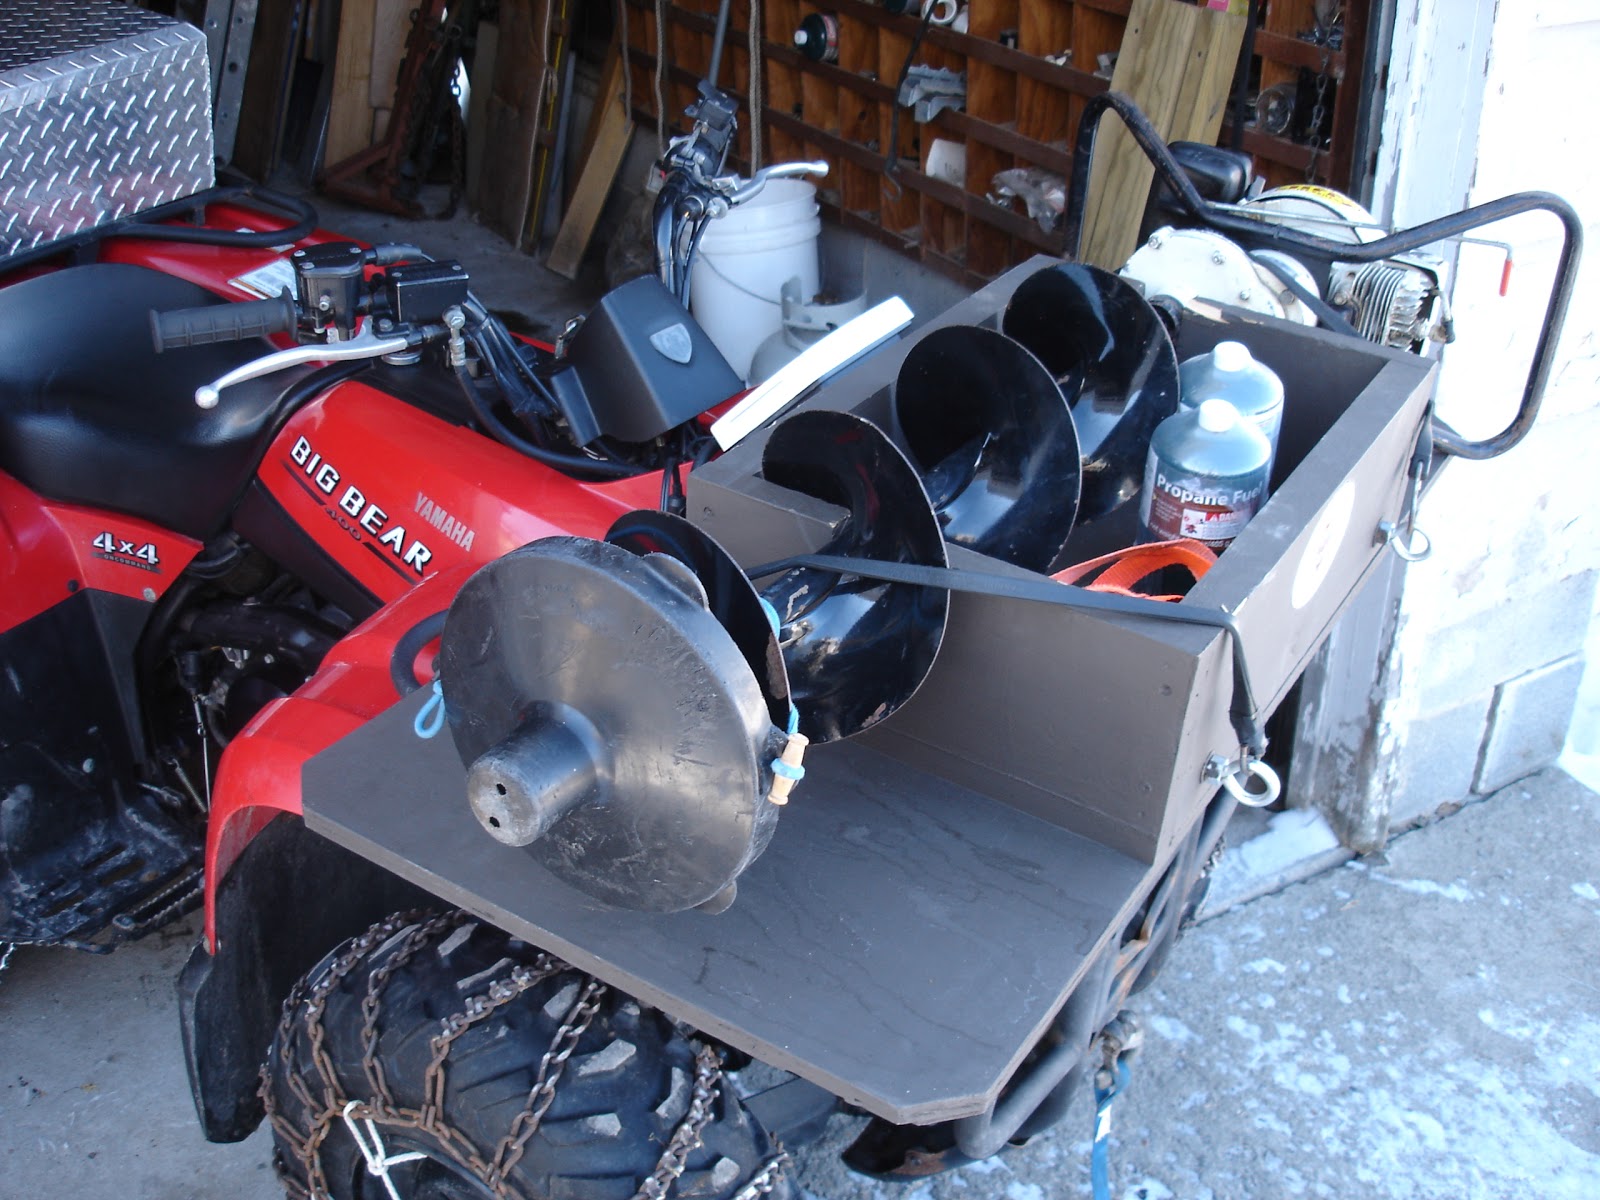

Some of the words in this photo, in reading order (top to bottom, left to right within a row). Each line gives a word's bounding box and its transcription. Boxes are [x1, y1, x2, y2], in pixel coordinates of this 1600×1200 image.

[290, 435, 340, 495] BIG
[338, 485, 432, 576] BEAR
[1157, 473, 1229, 506] Propane
[1232, 481, 1263, 505] Fuel
[325, 507, 362, 541] 400
[413, 491, 475, 552] YAMAHA
[92, 531, 160, 565] 4x4
